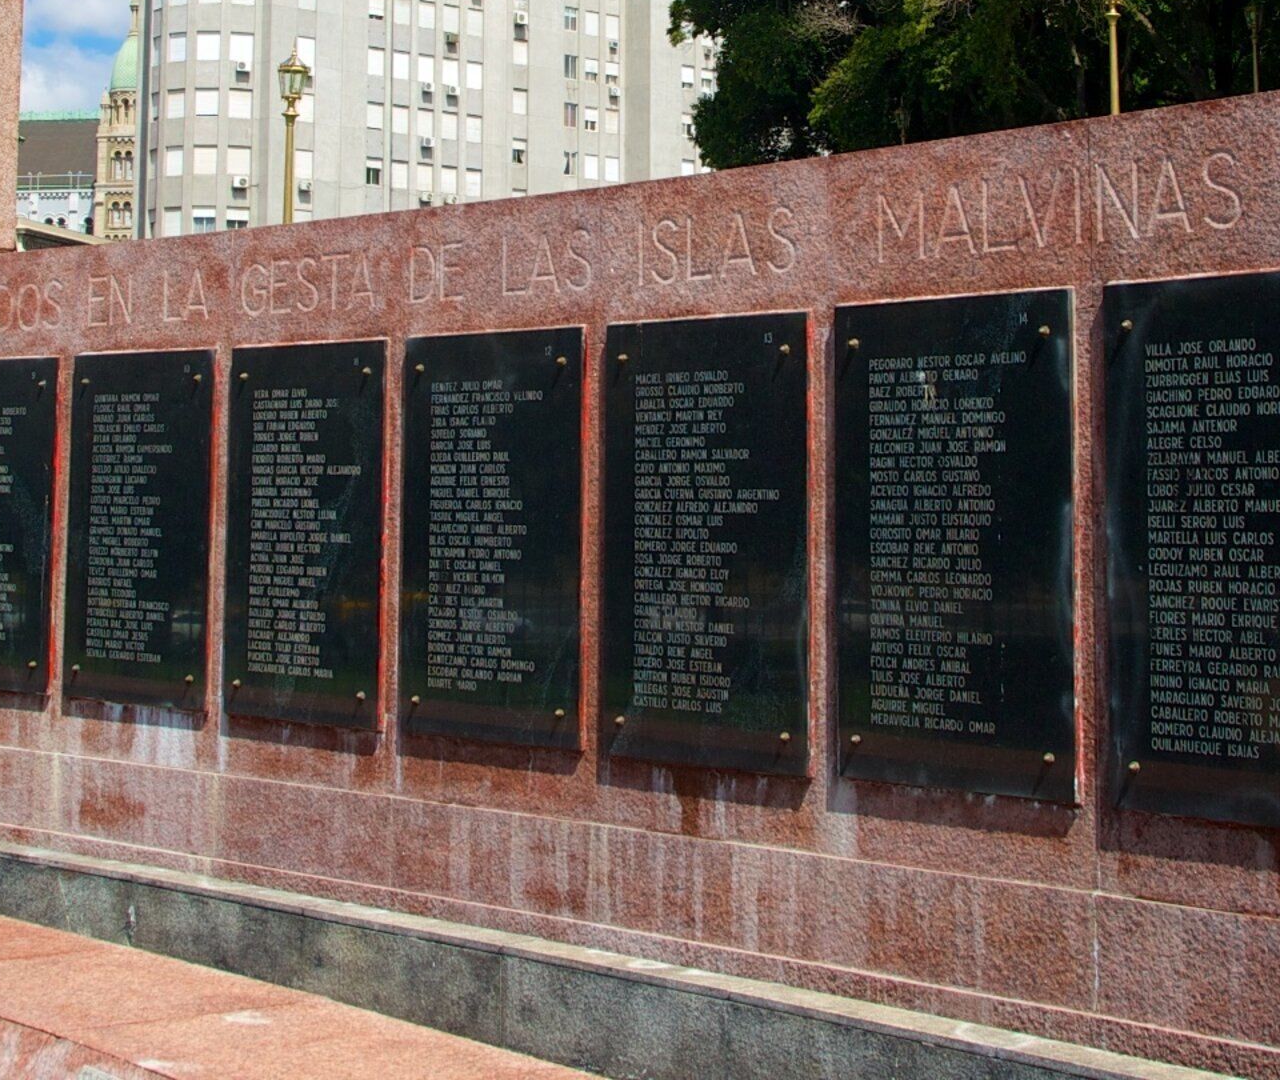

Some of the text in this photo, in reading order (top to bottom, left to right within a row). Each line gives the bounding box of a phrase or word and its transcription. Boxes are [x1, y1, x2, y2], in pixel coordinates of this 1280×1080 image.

[87, 272, 133, 326] EN
[163, 268, 209, 322] LA
[240, 251, 375, 316] GESTA
[408, 243, 463, 304] DE
[501, 229, 592, 296] LAS
[635, 206, 798, 286] ISLAS
[876, 152, 1244, 264] MALVINAS
[1145, 338, 1256, 356] VILLA JOSE ORLANDO
[869, 470, 980, 481] MOSTO CARLOS GUSTAVO
[1148, 531, 1274, 544] MARTELLA LUIS CARLOS
[870, 542, 978, 555] ESCOBAR RENE ANTONIO
[870, 556, 981, 570] SANCHEZ RICARDO JULIO
[1148, 579, 1275, 595] ROJAS RUBEN HORACIO
[1149, 610, 1276, 628] FLORES MARIO ENRIQUE
[1151, 705, 1208, 722] CABALLERO
[1214, 710, 1262, 726] ROBERTO
[1151, 721, 1193, 736] ROMERO
[1198, 725, 1242, 741] CLAUDIO
